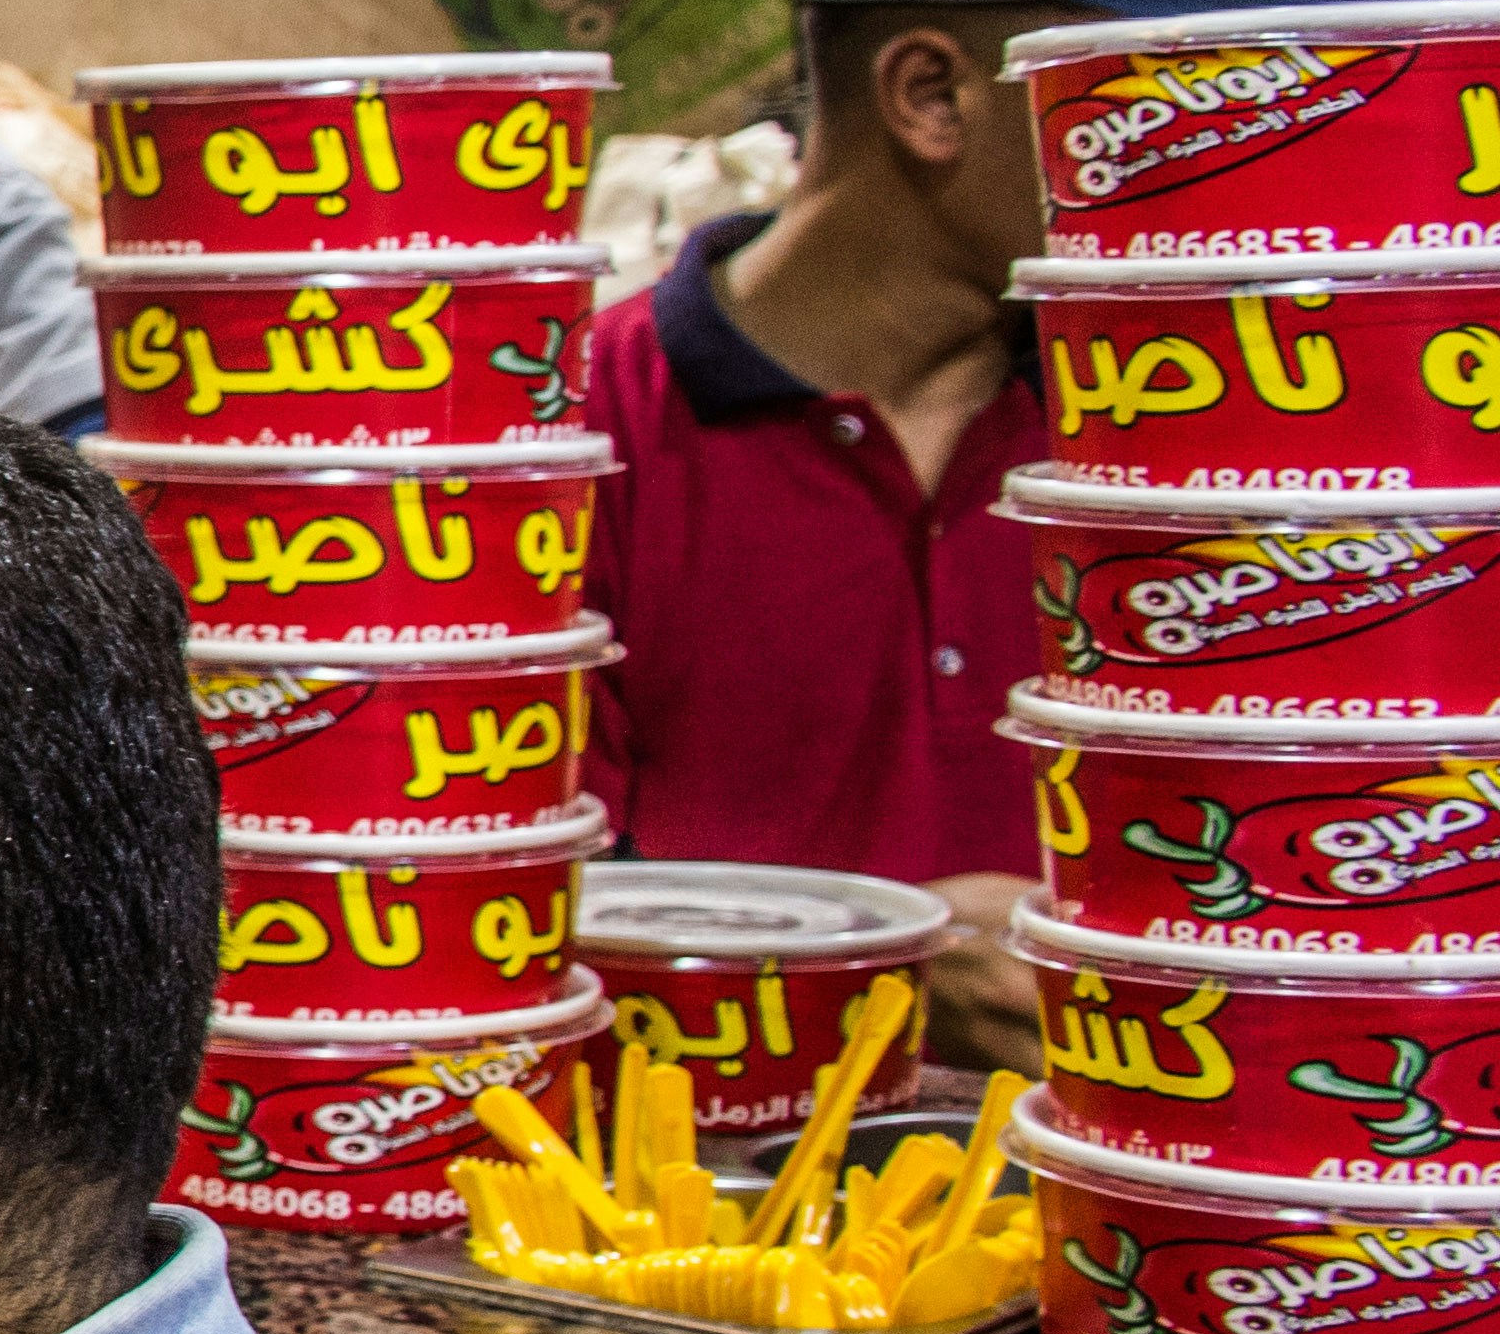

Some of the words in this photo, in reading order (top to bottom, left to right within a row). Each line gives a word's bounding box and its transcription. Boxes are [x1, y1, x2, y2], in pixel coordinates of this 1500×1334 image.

[112, 280, 455, 415] كشرى
[184, 475, 474, 605] ناصر
[1047, 966, 1235, 1099] كش
[180, 1174, 351, 1221] 4848068
[1312, 1158, 1500, 1184] 484806
